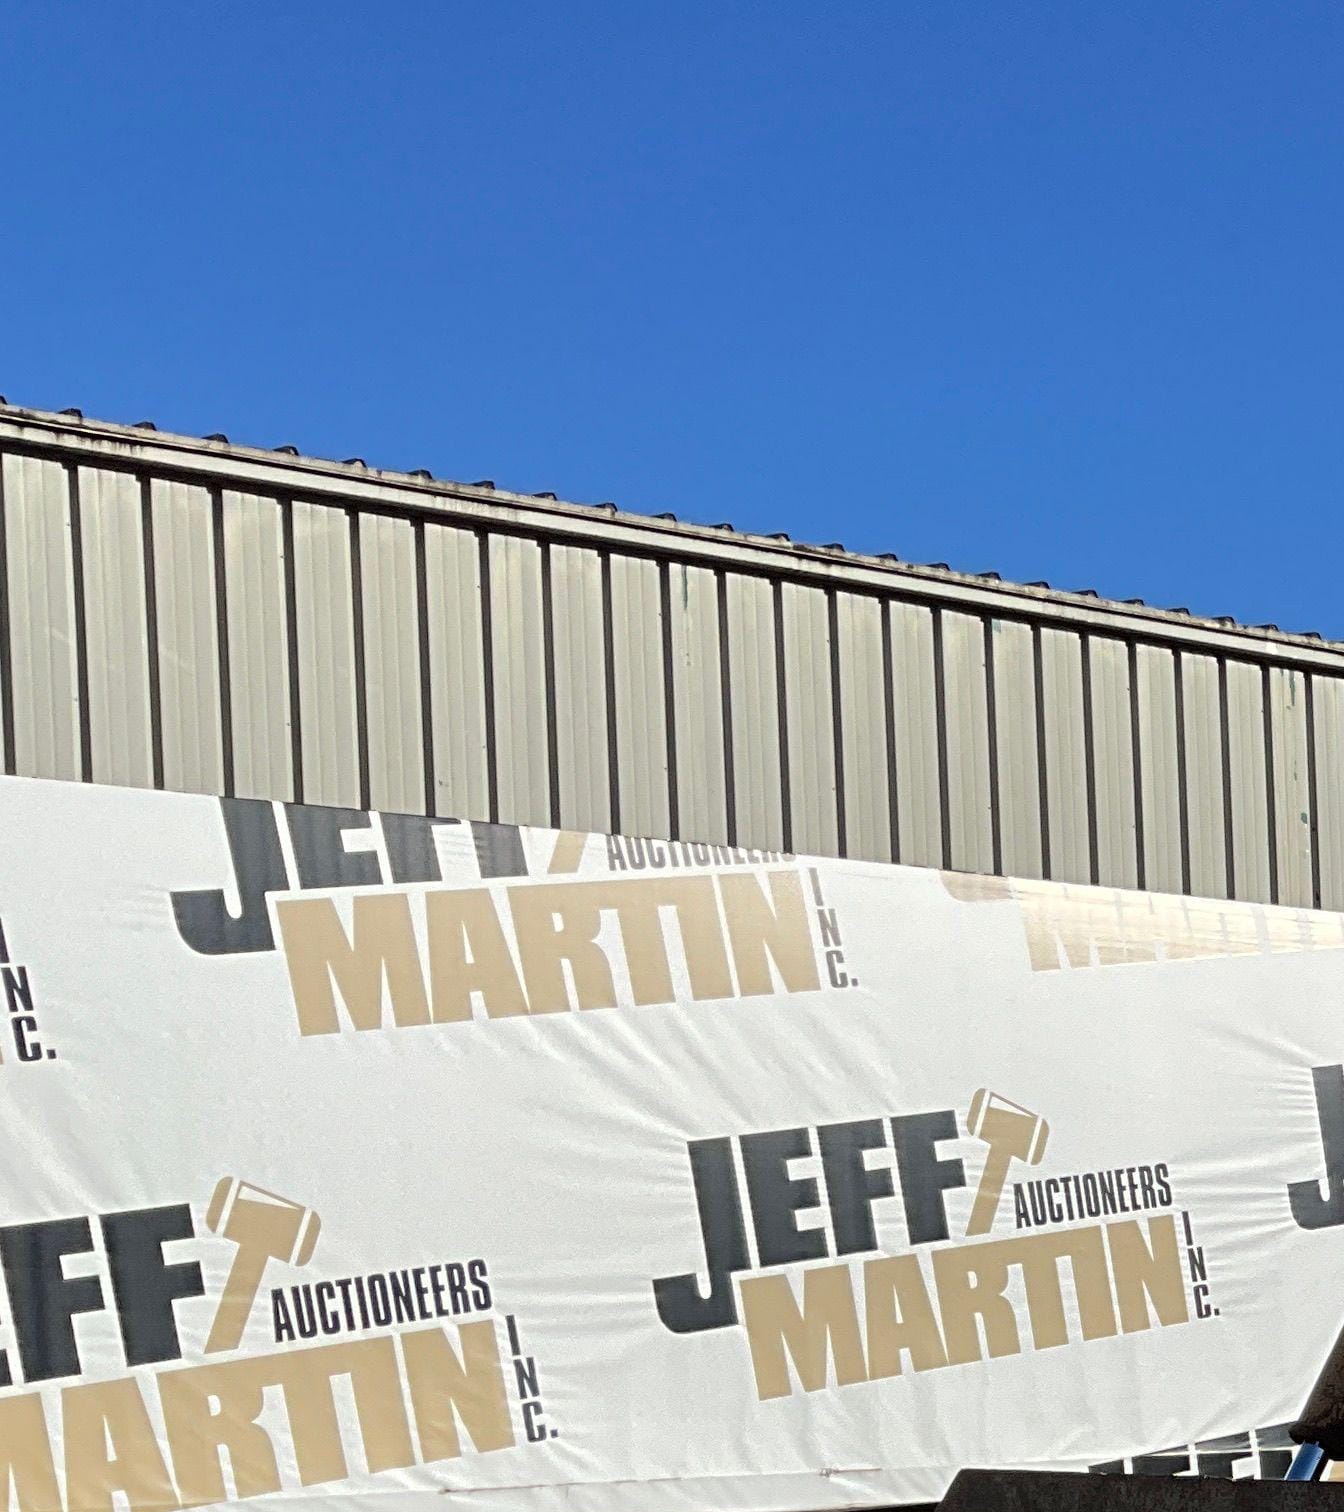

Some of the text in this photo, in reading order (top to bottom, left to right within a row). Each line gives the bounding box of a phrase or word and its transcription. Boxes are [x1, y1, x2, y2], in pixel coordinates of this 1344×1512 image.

[276, 869, 822, 1038] MARTIN
[653, 1110, 966, 1335] JEFF
[1013, 1163, 1173, 1229] AUCTIONEERS
[271, 1258, 493, 1343] AUCTIONEERS
[739, 1213, 1190, 1402] MARTIN
